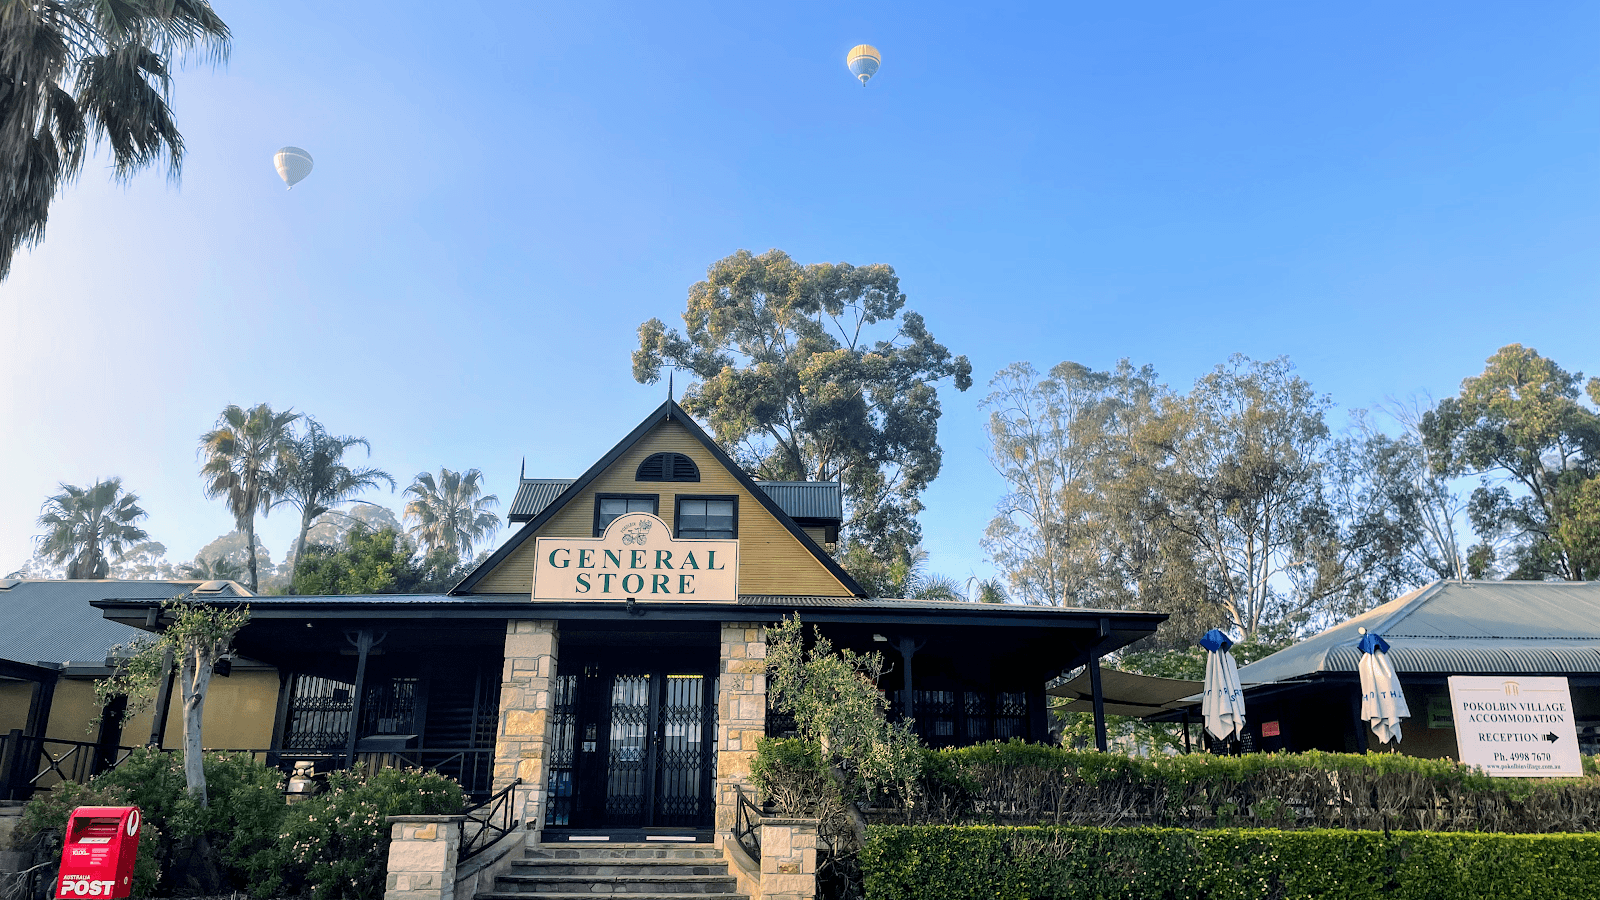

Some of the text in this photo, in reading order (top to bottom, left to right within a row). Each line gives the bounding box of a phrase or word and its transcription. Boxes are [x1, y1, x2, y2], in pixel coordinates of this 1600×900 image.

[549, 548, 725, 570] GENERAL
[575, 572, 696, 594] STORE
[1463, 702, 1567, 712] POKOLBIN VILLAGE
[1468, 714, 1564, 723] ACCOMMODATION
[1479, 733, 1539, 742] RECEPTION
[1493, 752, 1551, 762] Ph. 4998 7670
[61, 880, 115, 896] POST
